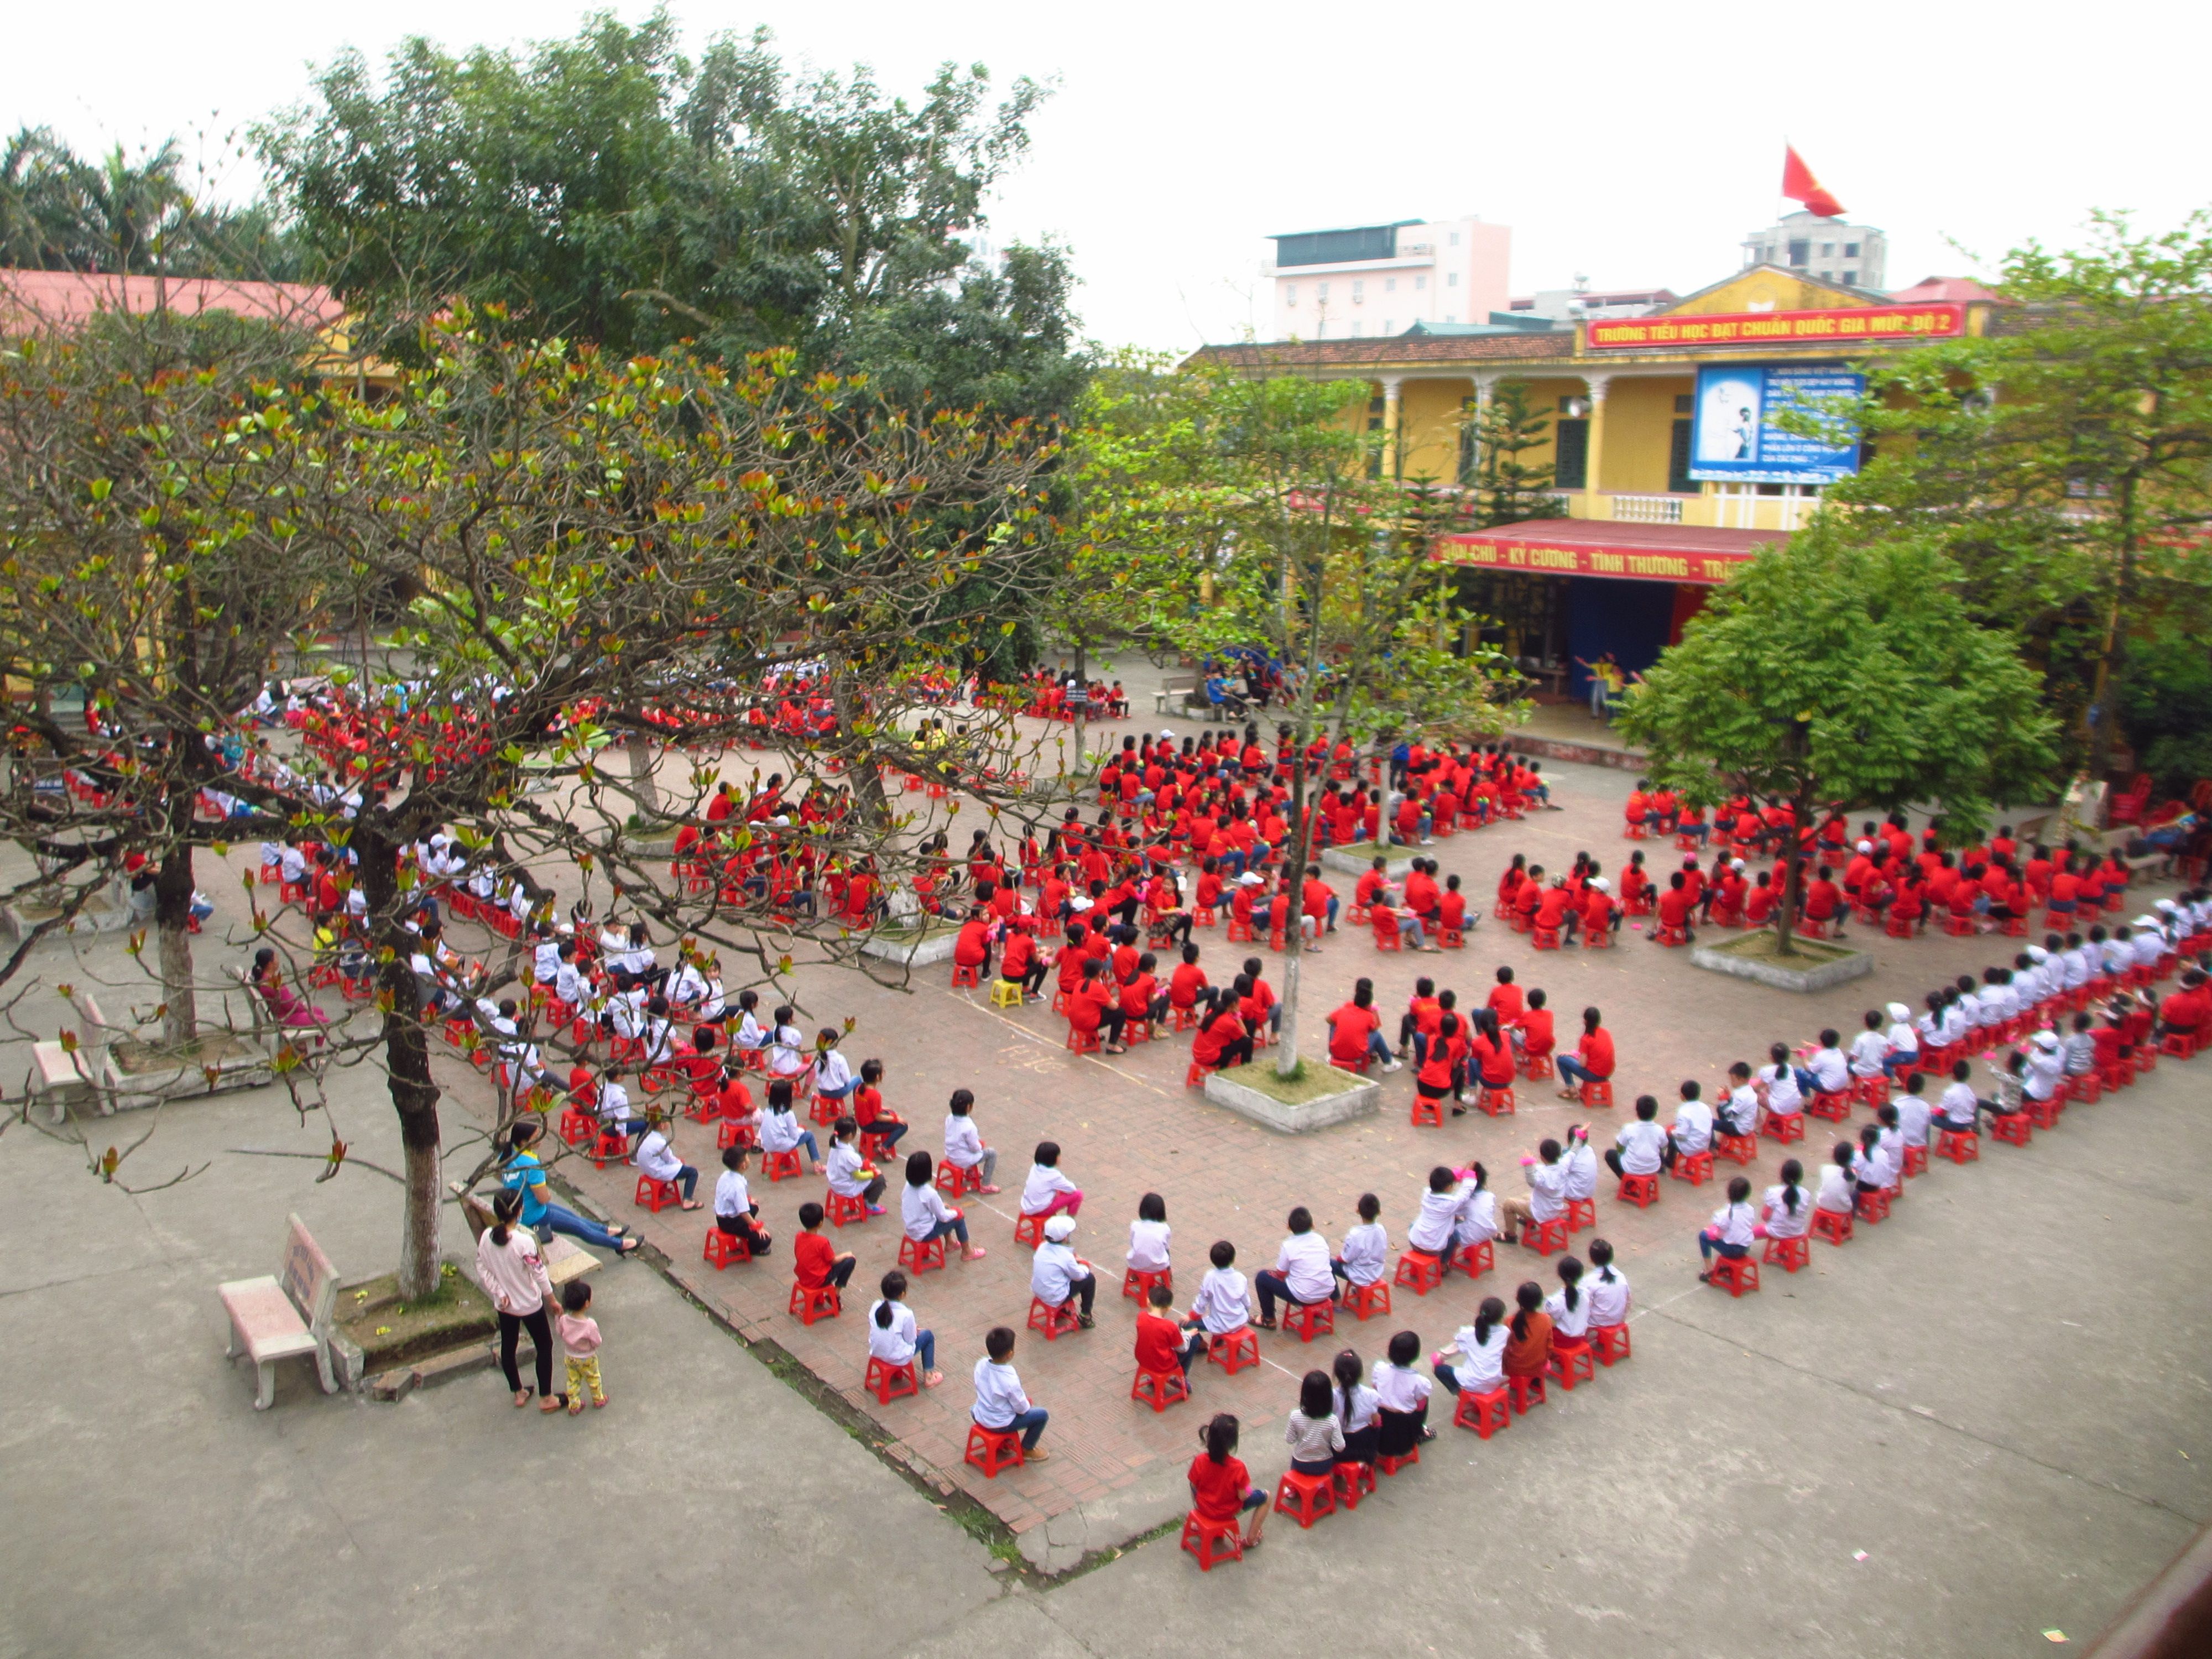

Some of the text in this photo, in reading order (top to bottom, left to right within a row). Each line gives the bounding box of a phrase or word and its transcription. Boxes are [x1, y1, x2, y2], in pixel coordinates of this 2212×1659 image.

[1681, 323, 1708, 341] HỌC
[1840, 317, 1865, 333] GIA
[1937, 314, 1951, 330] 2
[1530, 547, 1577, 570] CƯƠNG
[1590, 549, 1624, 572] TÌNH
[1628, 555, 1688, 576] THƯƠNG
